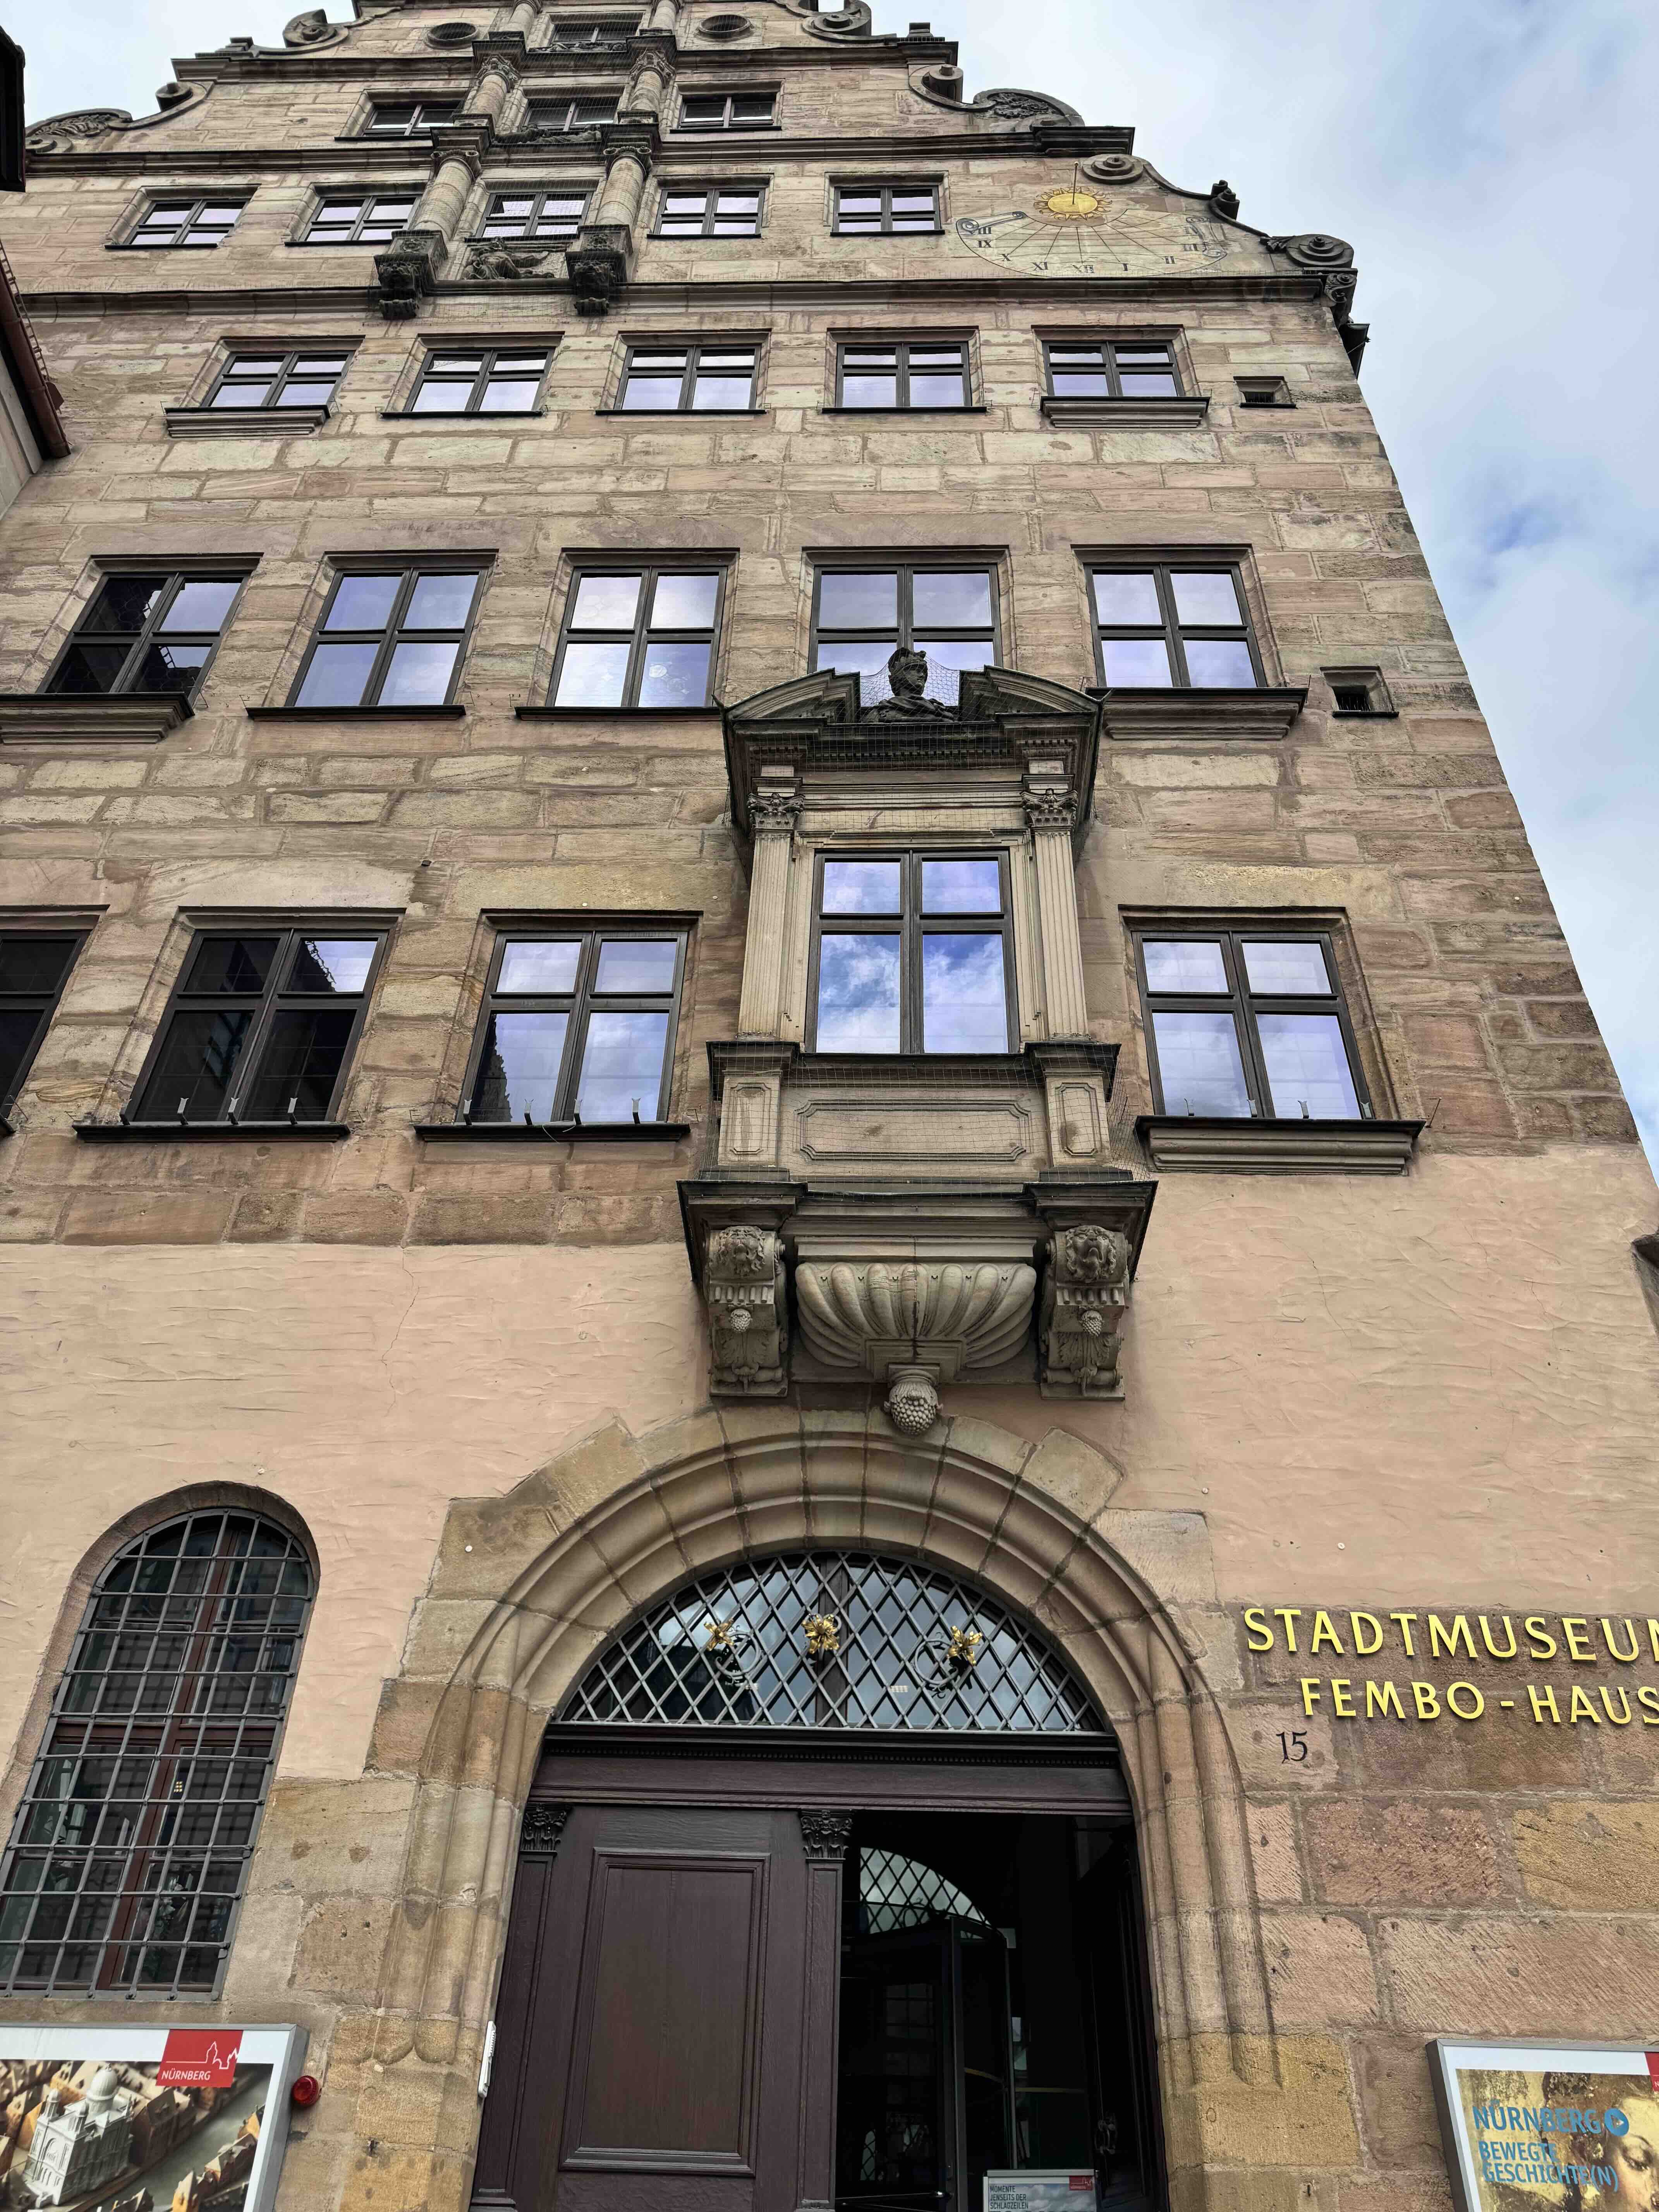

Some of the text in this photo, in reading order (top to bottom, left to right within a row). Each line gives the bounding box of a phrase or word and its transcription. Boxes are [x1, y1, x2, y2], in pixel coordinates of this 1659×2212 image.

[1032, 262, 1048, 270] XI
[1164, 256, 1176, 264] II
[1245, 1608, 1659, 1662] STADTMUSEU
[1276, 1731, 1307, 1764] 15
[161, 2068, 211, 2080] NÜRNBERG
[1473, 2099, 1602, 2134] NÜRNBERG
[1478, 2141, 1561, 2163] BEWEGTE
[1483, 2163, 1618, 2192] GESCHICHTE(N)
